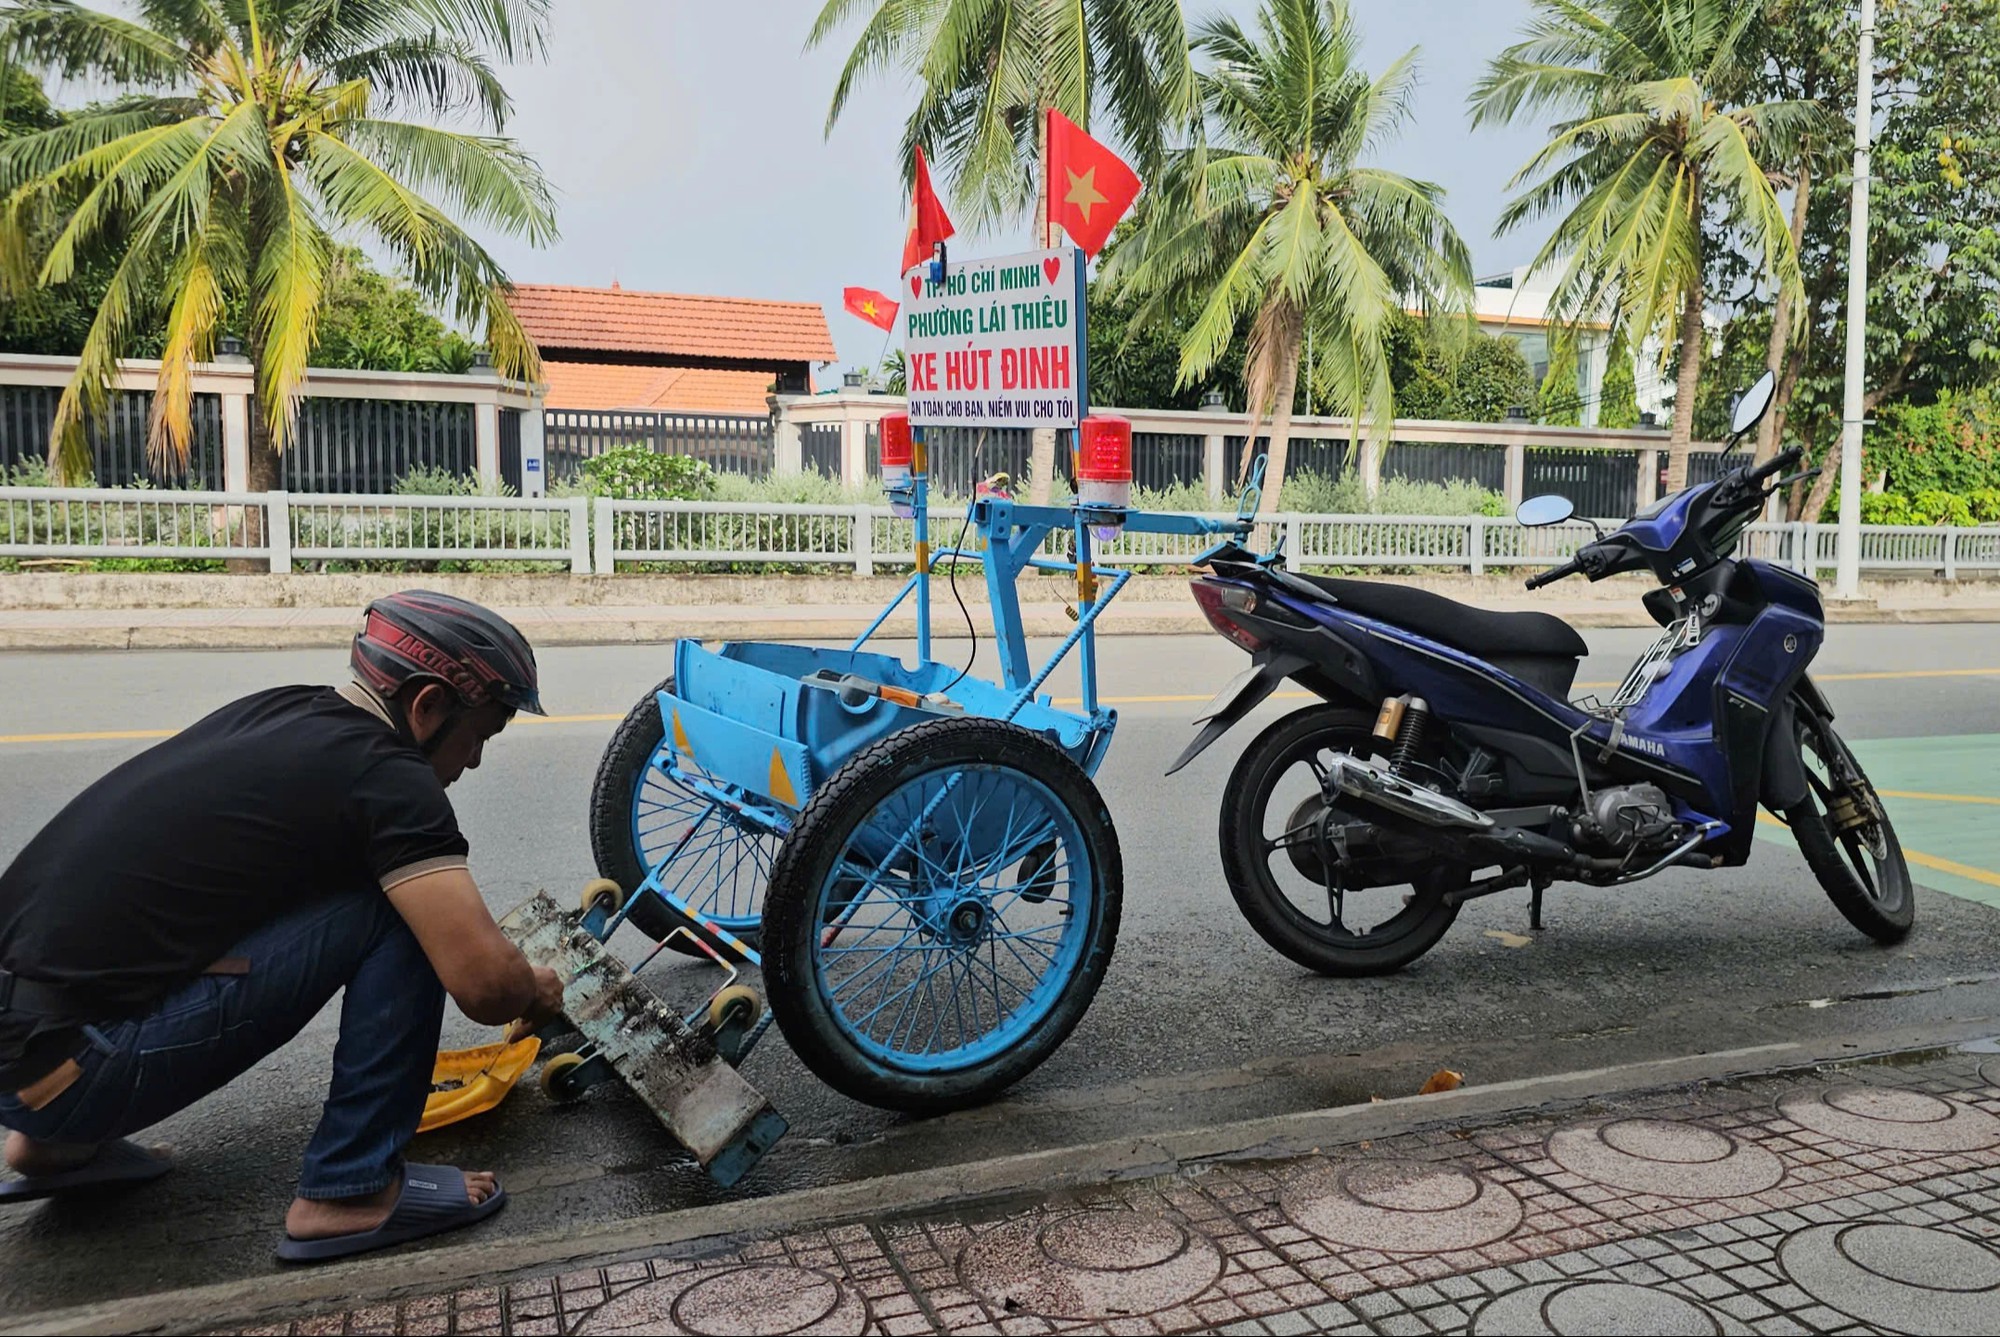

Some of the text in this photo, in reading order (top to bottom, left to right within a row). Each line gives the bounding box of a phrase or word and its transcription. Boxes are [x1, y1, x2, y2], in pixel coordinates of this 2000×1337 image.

[925, 279, 943, 298] TP.
[971, 265, 995, 294] CHÍ
[1000, 264, 1040, 290] MINH
[908, 295, 1068, 338] PHƯỜNG LÁI THIÊU
[911, 341, 1070, 391] XE HÚT ĐINH
[911, 401, 921, 417] AN
[923, 397, 943, 417] TOÀN
[945, 400, 963, 417] CHO
[965, 400, 986, 421] BẠN,
[1015, 400, 1030, 417] VUI
[1033, 400, 1053, 418] CHO
[1057, 396, 1073, 418] TÔI
[395, 633, 457, 676] ARCTIC
[1619, 733, 1665, 757] AMAHA
